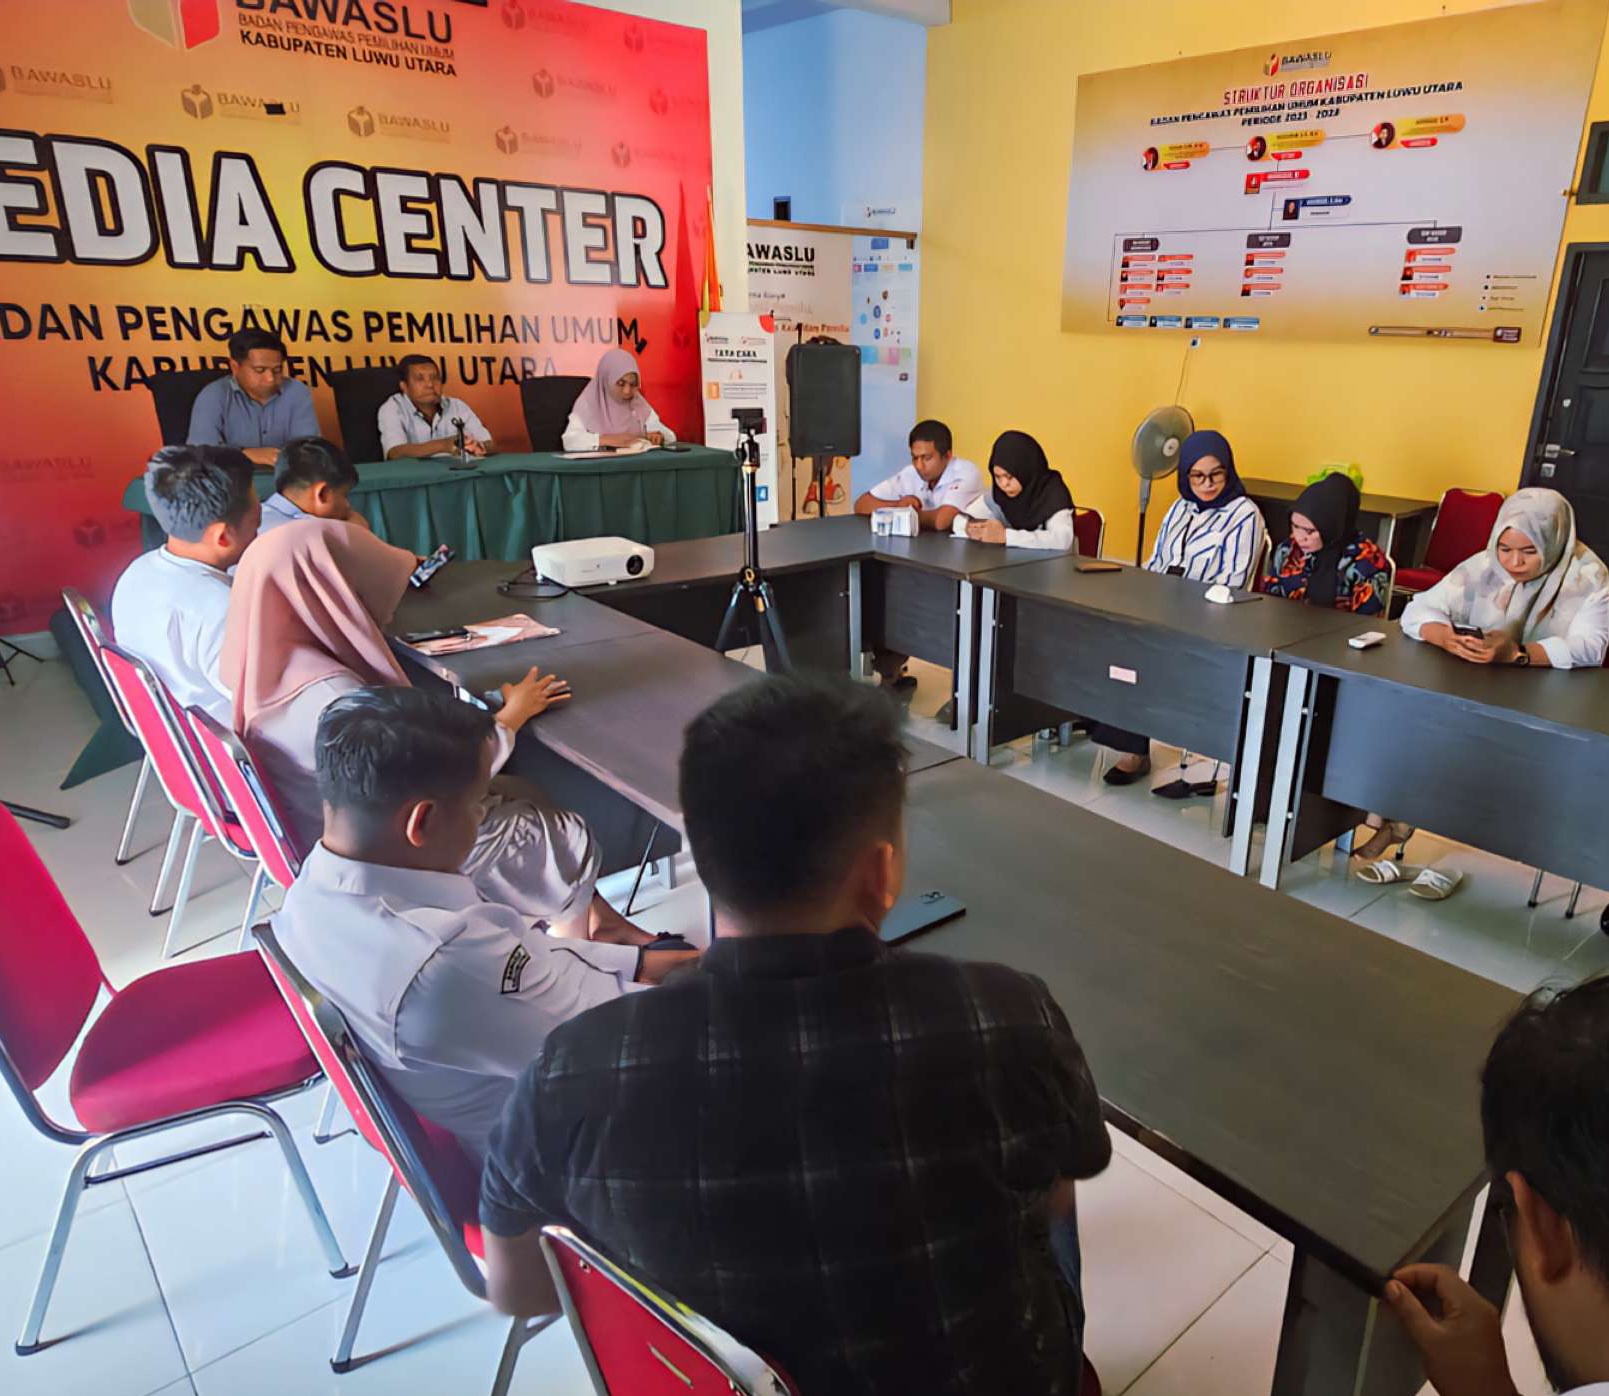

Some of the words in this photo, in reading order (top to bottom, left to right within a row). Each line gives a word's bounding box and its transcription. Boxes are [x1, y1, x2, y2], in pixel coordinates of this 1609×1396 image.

[239, 13, 283, 31] BADAN
[286, 21, 355, 44] PENGAWAS
[241, 30, 347, 60] KABUPATEN
[352, 46, 400, 69] LUWU
[404, 56, 457, 77] UTARA
[11, 65, 111, 89] BAWASLU
[1387, 86, 1421, 99] LUWU
[1423, 81, 1463, 95] UTARA
[379, 113, 451, 133] BAWASLU
[303, 160, 669, 289] CENTER
[116, 305, 353, 343] PENGAWAS
[364, 310, 541, 344] PEMILIHAN
[551, 315, 639, 345] UMUM
